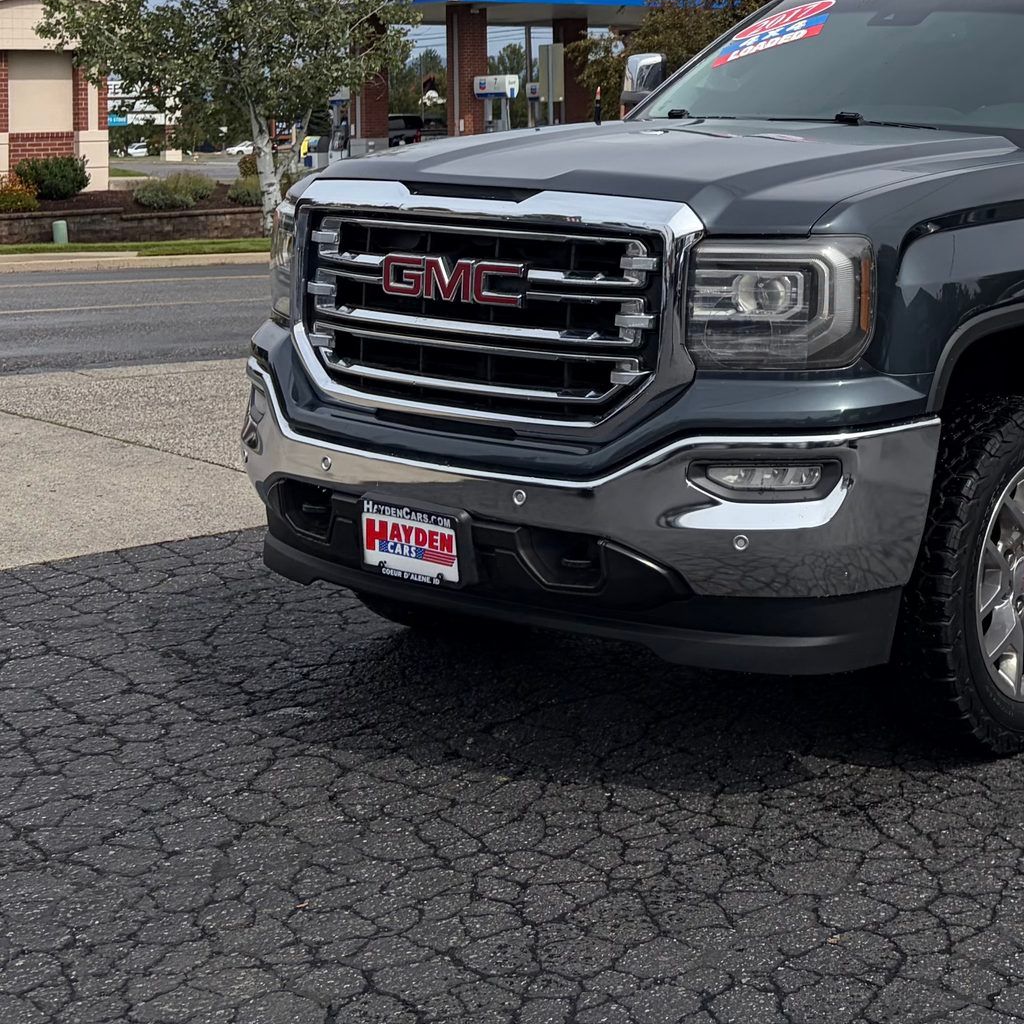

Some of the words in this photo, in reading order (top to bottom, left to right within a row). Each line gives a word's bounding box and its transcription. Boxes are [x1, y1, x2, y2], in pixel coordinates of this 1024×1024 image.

[726, 29, 809, 62] LOADED
[382, 253, 525, 309] GMC
[366, 518, 453, 553] HAYDEN
[387, 542, 416, 558] CARS
[382, 567, 402, 578] COEUR
